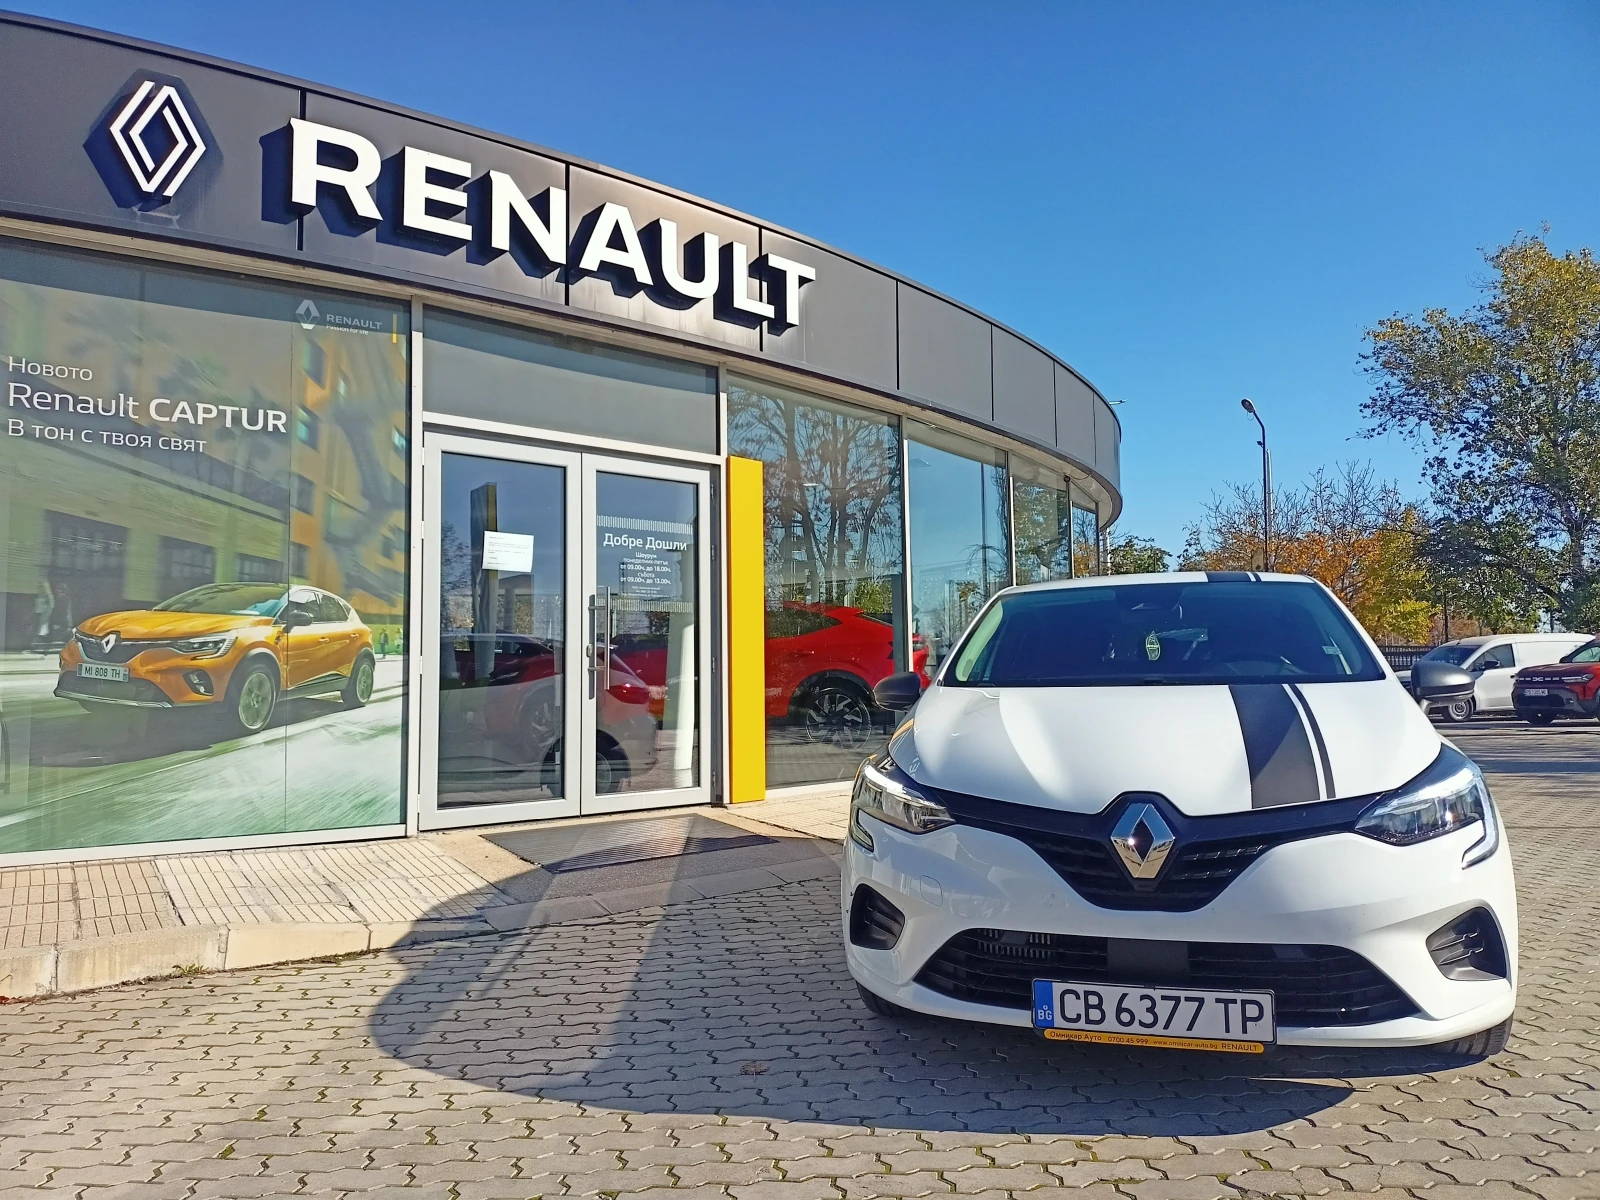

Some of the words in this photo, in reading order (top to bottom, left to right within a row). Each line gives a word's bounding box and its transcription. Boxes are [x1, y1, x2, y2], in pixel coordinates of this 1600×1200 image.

[290, 117, 815, 328] RENAULT
[326, 313, 382, 330] RENAULT
[8, 356, 93, 381] Новото
[8, 382, 140, 419] Renault
[149, 398, 287, 433] CAPTUR
[7, 418, 24, 437] В
[31, 425, 74, 441] тон
[81, 429, 93, 443] с
[99, 431, 152, 448] твоя
[158, 437, 207, 453] свят
[603, 532, 643, 550] Добре
[645, 536, 687, 551] Дошли
[84, 666, 93, 676] MI
[95, 667, 108, 677] 808
[111, 668, 121, 679] TH
[1037, 1009, 1052, 1020] BG
[1059, 988, 1106, 1025] CB
[1115, 992, 1206, 1032] 6377
[1215, 997, 1265, 1035] TP
[1050, 1031, 1082, 1041] Омникар
[1084, 1033, 1102, 1041] Ауто
[1152, 1040, 1218, 1050] www.omnicar-auto.bg
[1221, 1042, 1258, 1052] RENAULT
